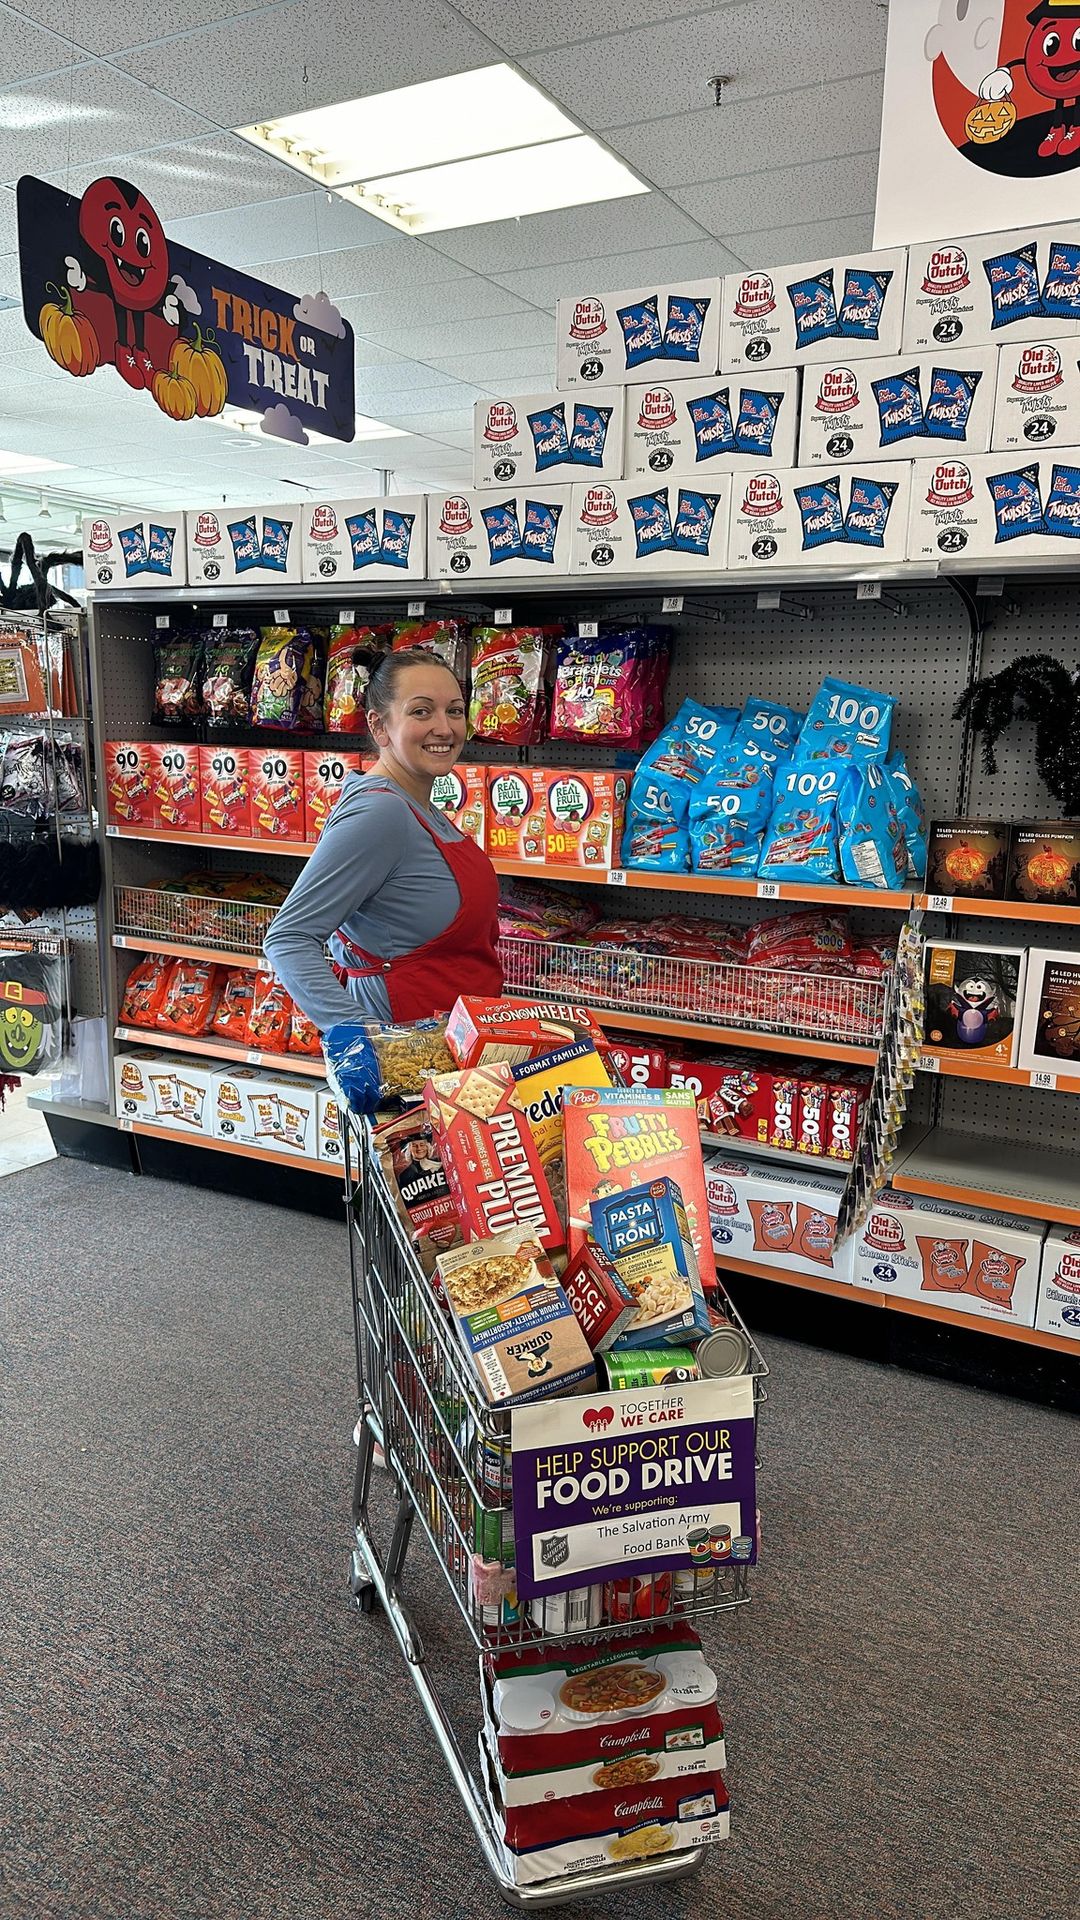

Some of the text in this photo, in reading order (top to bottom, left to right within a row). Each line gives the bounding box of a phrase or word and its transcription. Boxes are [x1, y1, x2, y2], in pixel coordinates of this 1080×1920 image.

[932, 253, 950, 264] Old
[931, 265, 962, 278] Dutch
[742, 280, 759, 290] Old
[742, 292, 769, 303] Dutch
[576, 303, 590, 314] Old
[212, 286, 316, 362] TRICK OR
[576, 315, 600, 325] Dutch
[940, 323, 956, 336] 24
[751, 343, 766, 355] 24
[1023, 350, 1043, 360] Old
[586, 363, 598, 375] 24
[1022, 361, 1055, 375] Dutch
[243, 342, 329, 410] TREAT
[824, 373, 842, 384] Old
[824, 385, 852, 396] Dutch
[645, 393, 660, 402] Old
[490, 406, 504, 416] Old
[645, 403, 670, 414] Dutch
[490, 416, 512, 426] Dutch
[1031, 422, 1048, 434] 24
[833, 440, 847, 451] 24
[654, 455, 668, 465] 24
[500, 466, 511, 475] 24
[936, 467, 955, 478] Old
[750, 479, 766, 490] Old
[935, 478, 966, 491] Dutch
[588, 490, 602, 500] Old
[750, 490, 776, 501] Dutch
[445, 501, 458, 510] Old
[588, 502, 612, 511] Dutch
[199, 516, 209, 524] Old
[445, 511, 467, 520] Dutch
[944, 534, 960, 545] 24
[758, 542, 772, 553] 24
[597, 550, 609, 560] 24
[455, 558, 466, 567] 24
[207, 566, 218, 575] 24
[576, 652, 608, 664] Candy
[562, 664, 621, 676] Bracelets
[828, 695, 879, 730] 100
[484, 716, 498, 726] 40
[752, 712, 787, 735] 50
[685, 716, 717, 740] 50
[116, 751, 138, 769] 90
[163, 753, 185, 772] 90
[212, 757, 235, 775] 90
[263, 759, 286, 778] 90
[319, 762, 344, 782] 90
[433, 778, 454, 787] REAL
[497, 782, 520, 792] REAL
[786, 771, 836, 796] 100
[433, 787, 454, 796] FRUIT
[498, 791, 520, 800] FRUIT
[556, 786, 580, 797] REAL
[557, 795, 580, 805] FRUIT
[643, 786, 672, 812] 50
[706, 795, 740, 815] 50
[490, 829, 506, 846] 50
[548, 835, 565, 852] 50
[612, 872, 622, 880] 12.99
[762, 885, 775, 895] 19.99
[933, 898, 947, 906] 12.49
[485, 1001, 511, 1012] original
[476, 1005, 592, 1027] WAGON WHEELS
[520, 1044, 589, 1076] FORMAT FAMILIAL
[1036, 1074, 1050, 1083] 14.99
[574, 1092, 596, 1104] Post
[666, 1092, 690, 1100] SANS
[775, 1101, 791, 1130] 50
[802, 1105, 820, 1135] 50
[832, 1110, 850, 1140] 50
[584, 1127, 684, 1173] PEBBLES
[486, 1112, 551, 1238] PREMIUM
[400, 1172, 446, 1201] QUAKE
[610, 1202, 653, 1226] PASTA
[871, 1215, 888, 1228] Old
[615, 1224, 656, 1248] RONI
[871, 1226, 899, 1240] Dutch
[858, 1246, 891, 1262] Cheese
[575, 1270, 605, 1317] RICE
[540, 1301, 566, 1313] FLAVOUR
[566, 1283, 596, 1332] RONI
[506, 1330, 553, 1356] QUAKER
[621, 1397, 684, 1415] TOGETHER
[621, 1407, 684, 1428] WE CARE
[536, 1452, 583, 1478] HELP
[590, 1435, 679, 1469] SUPPORT
[686, 1429, 730, 1453] OUR
[537, 1452, 733, 1508] FOOD DRIVE
[592, 1495, 678, 1516] We're supporting:
[598, 1513, 710, 1539] The Salvation Army
[624, 1536, 685, 1556] Food Bank
[551, 1550, 566, 1565] ARMY
[571, 1658, 605, 1674] VEGETABLE
